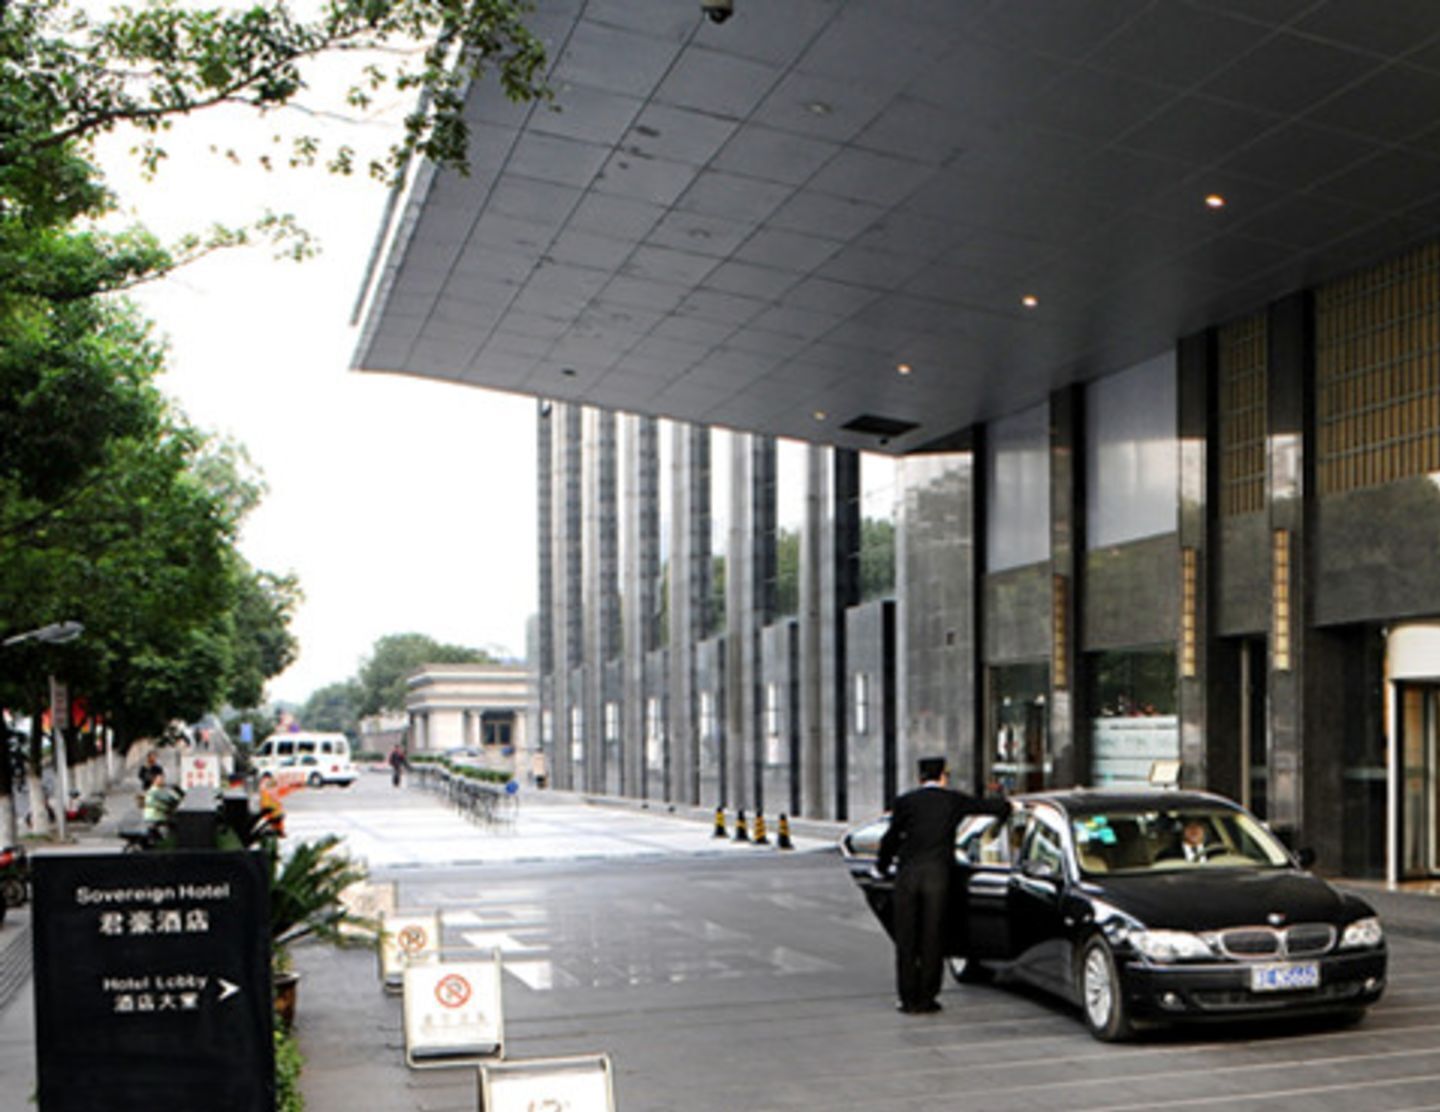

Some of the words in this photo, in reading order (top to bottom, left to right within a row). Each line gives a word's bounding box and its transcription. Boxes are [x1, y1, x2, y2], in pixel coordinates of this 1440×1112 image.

[76, 886, 176, 905] Sovereign
[179, 882, 230, 900] Hotel
[99, 908, 209, 935] 君豪酒店
[103, 976, 149, 991] Hotel
